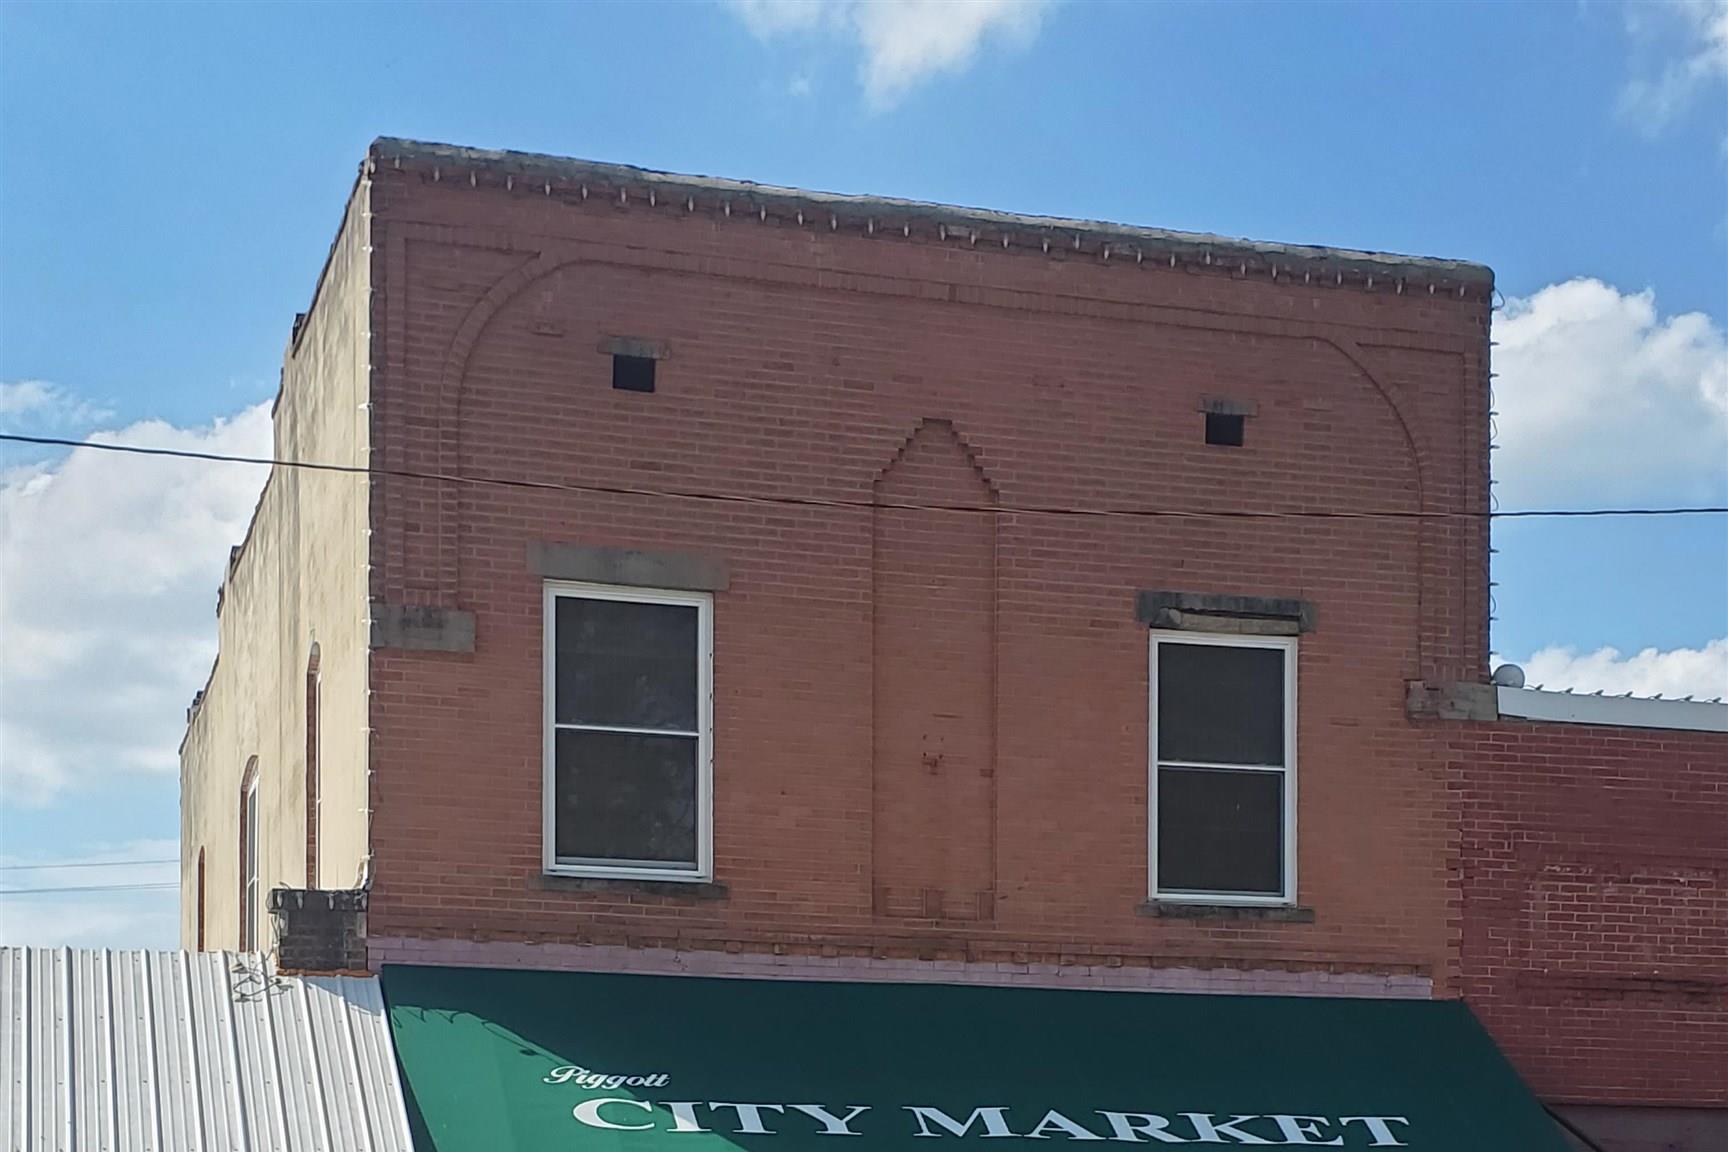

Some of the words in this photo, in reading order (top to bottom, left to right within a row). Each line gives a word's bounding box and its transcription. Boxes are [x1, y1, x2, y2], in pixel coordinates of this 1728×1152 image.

[544, 1066, 671, 1089] Piggott
[573, 1098, 872, 1135] CITY
[901, 1106, 1410, 1146] MARKET
